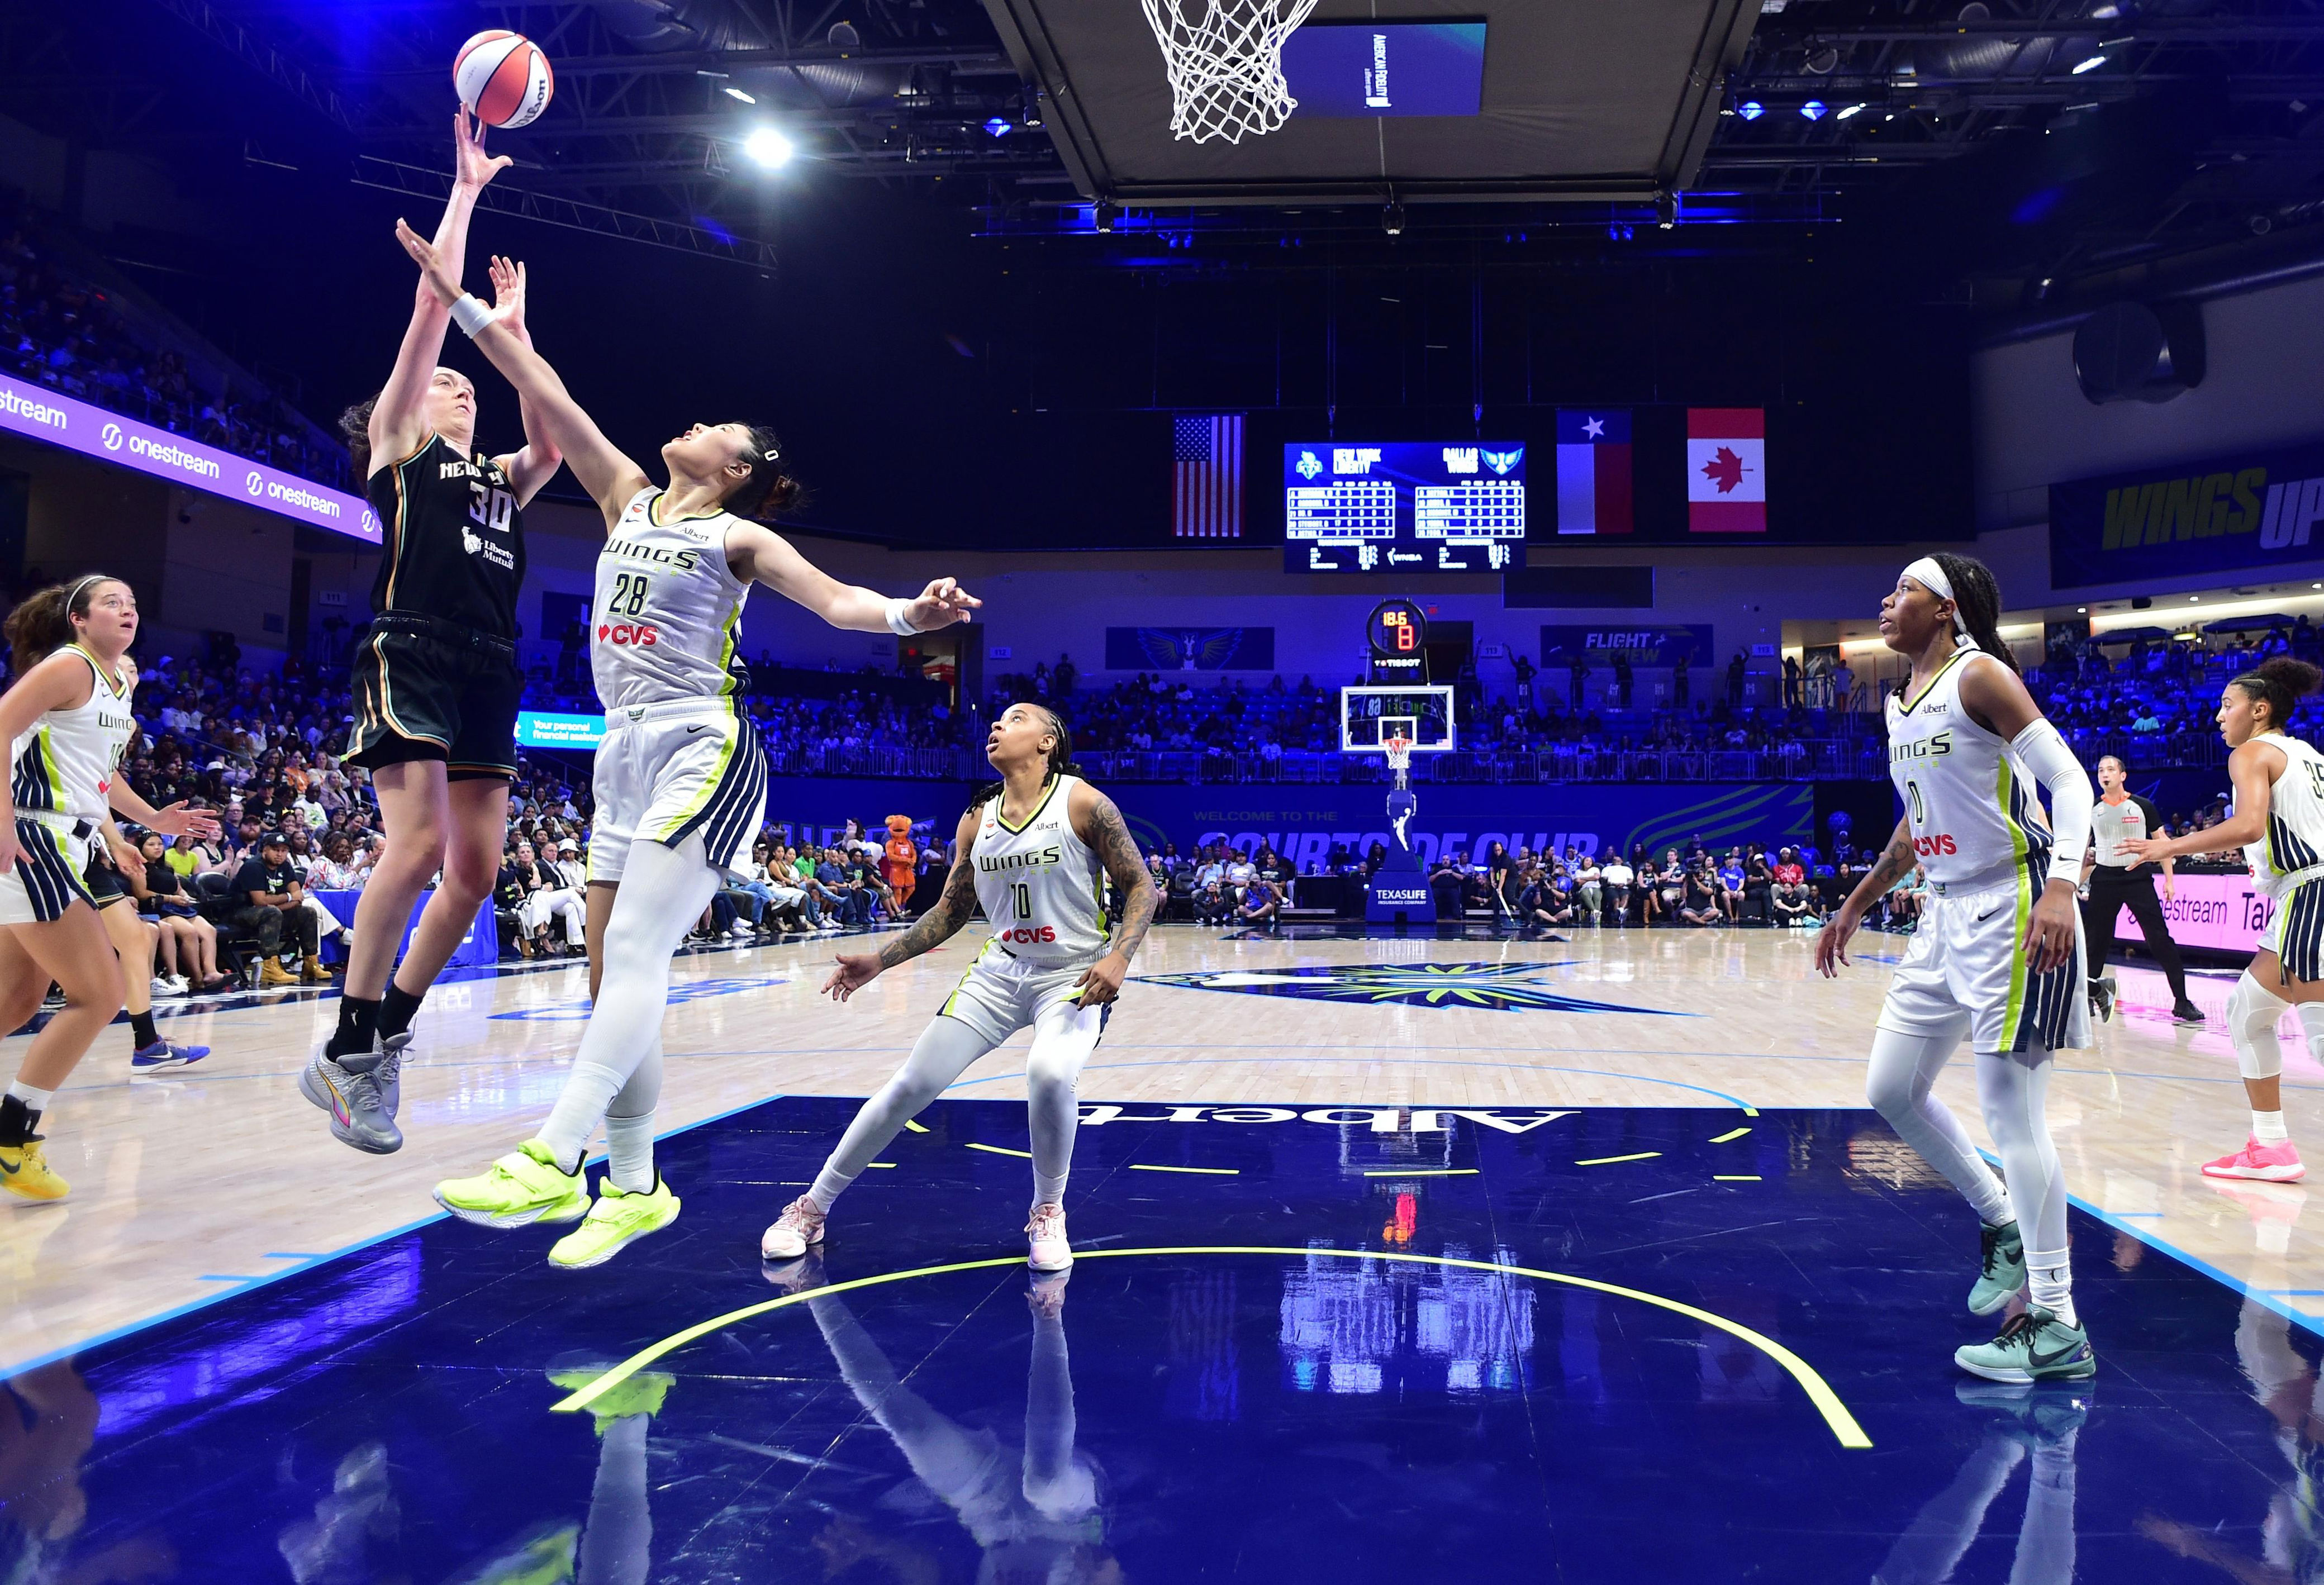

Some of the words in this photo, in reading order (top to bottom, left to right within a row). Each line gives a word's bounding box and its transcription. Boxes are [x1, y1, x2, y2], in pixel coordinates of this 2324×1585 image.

[1373, 35, 1386, 69] AMERICAN
[1375, 70, 1388, 96] FIDELITY
[129, 436, 220, 479] onestream
[440, 461, 482, 479] NEW
[268, 481, 340, 518] onestream
[469, 480, 512, 532] 30
[2102, 467, 2266, 551] WINGS
[681, 527, 709, 541] Albert
[483, 550, 514, 570] Mutual
[484, 540, 514, 560] Liberty
[602, 538, 698, 570] WINGS
[608, 572, 649, 617] 28
[1383, 612, 1407, 626] 18.6
[612, 625, 658, 645] CVS
[1398, 625, 1413, 650] 8
[1586, 633, 1651, 648] FLIGHT
[1387, 659, 1420, 667] TISSOT
[1921, 703, 1946, 714] Albert
[99, 712, 131, 730] WING
[533, 720, 553, 730] Your
[553, 722, 590, 732] personal
[533, 730, 569, 740] financial
[1890, 732, 1951, 762] INGS
[1035, 821, 1059, 831] Albert
[1193, 811, 1275, 821] WELCOME
[1280, 811, 1301, 821] TO
[1306, 811, 1338, 821] THE
[980, 846, 1060, 872] WINGS
[1010, 883, 1031, 919] 10
[1376, 889, 1427, 899] TEXASLIFE
[2158, 894, 2227, 925] estream
[1014, 926, 1056, 944] CVS
[1078, 1106, 1582, 1134] Albert
